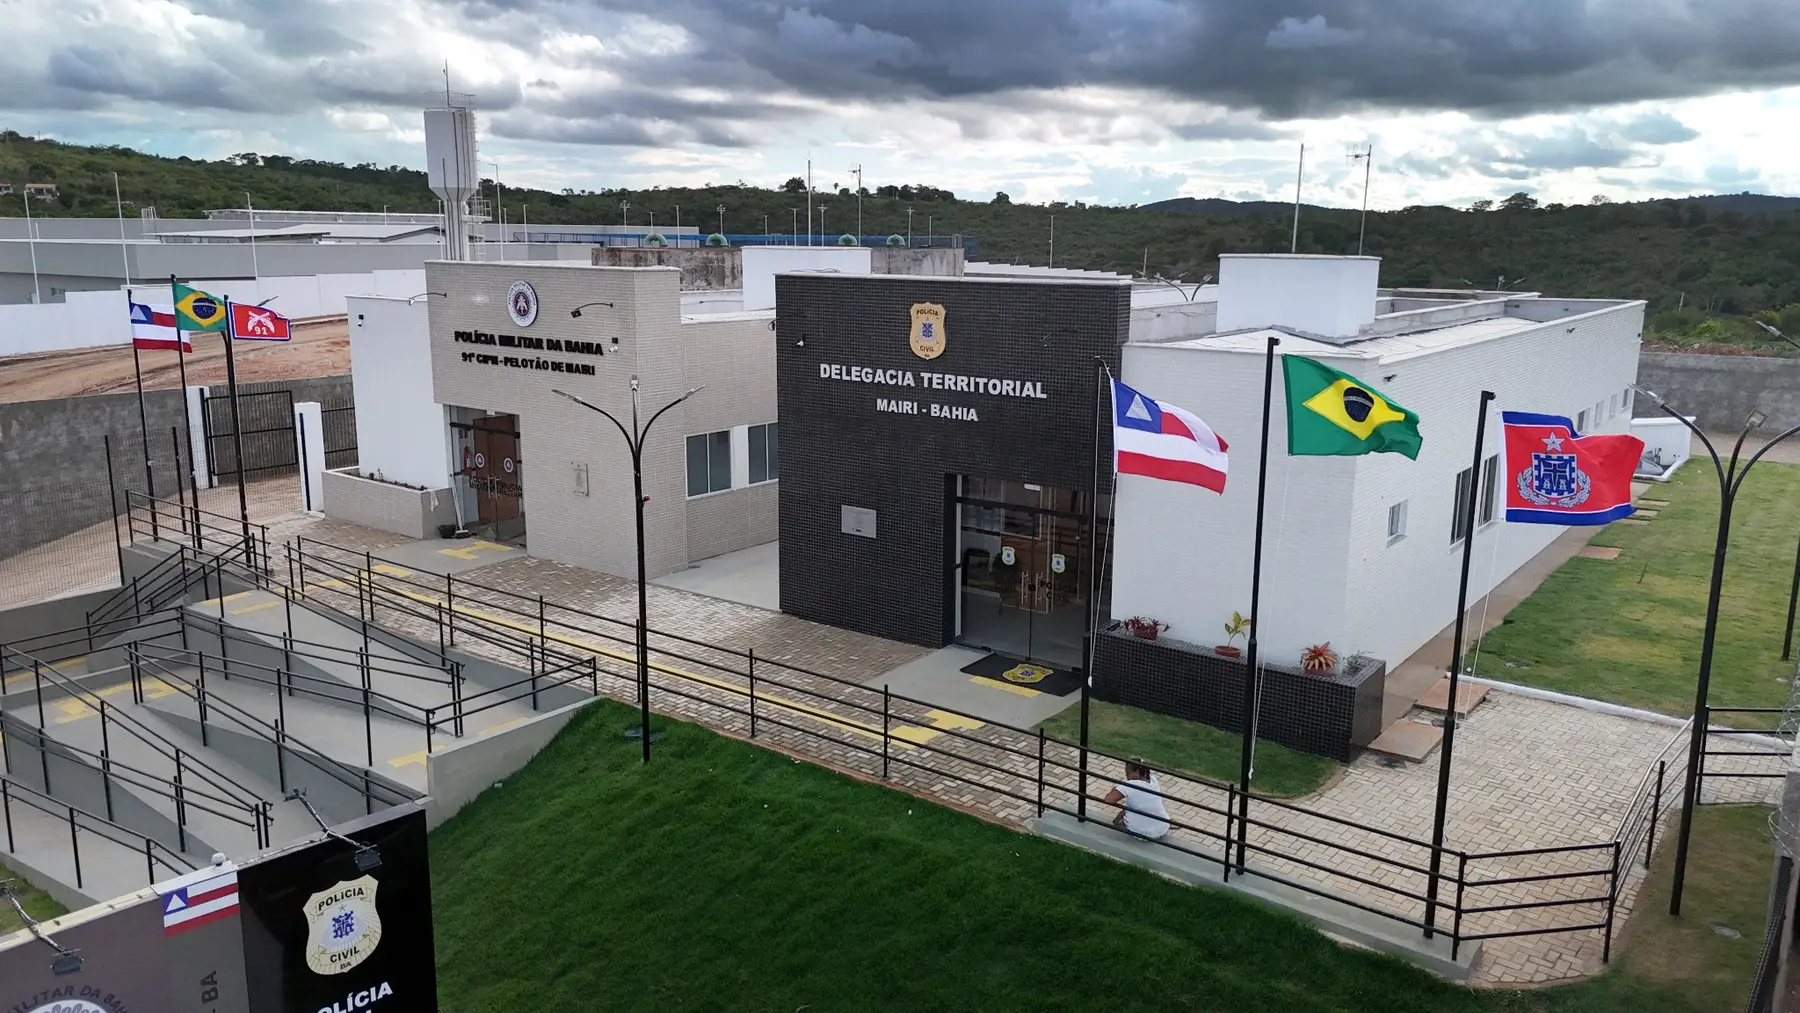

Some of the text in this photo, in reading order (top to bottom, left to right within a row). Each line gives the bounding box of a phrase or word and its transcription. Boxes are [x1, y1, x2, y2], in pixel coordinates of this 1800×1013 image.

[254, 325, 268, 336] 91
[454, 330, 604, 355] POLÍCIA MILITAR DA BAHIA
[551, 361, 564, 372] DE
[566, 363, 595, 376] MAIRI
[820, 363, 1047, 399] DELEGACIA TERRITORIAL
[876, 399, 918, 415] MAIRI
[930, 404, 979, 422] BAHIA
[330, 946, 360, 963] CIVIL
[7, 985, 75, 1013] ILITAR
[80, 985, 102, 998] DA
[201, 970, 219, 1005] BA
